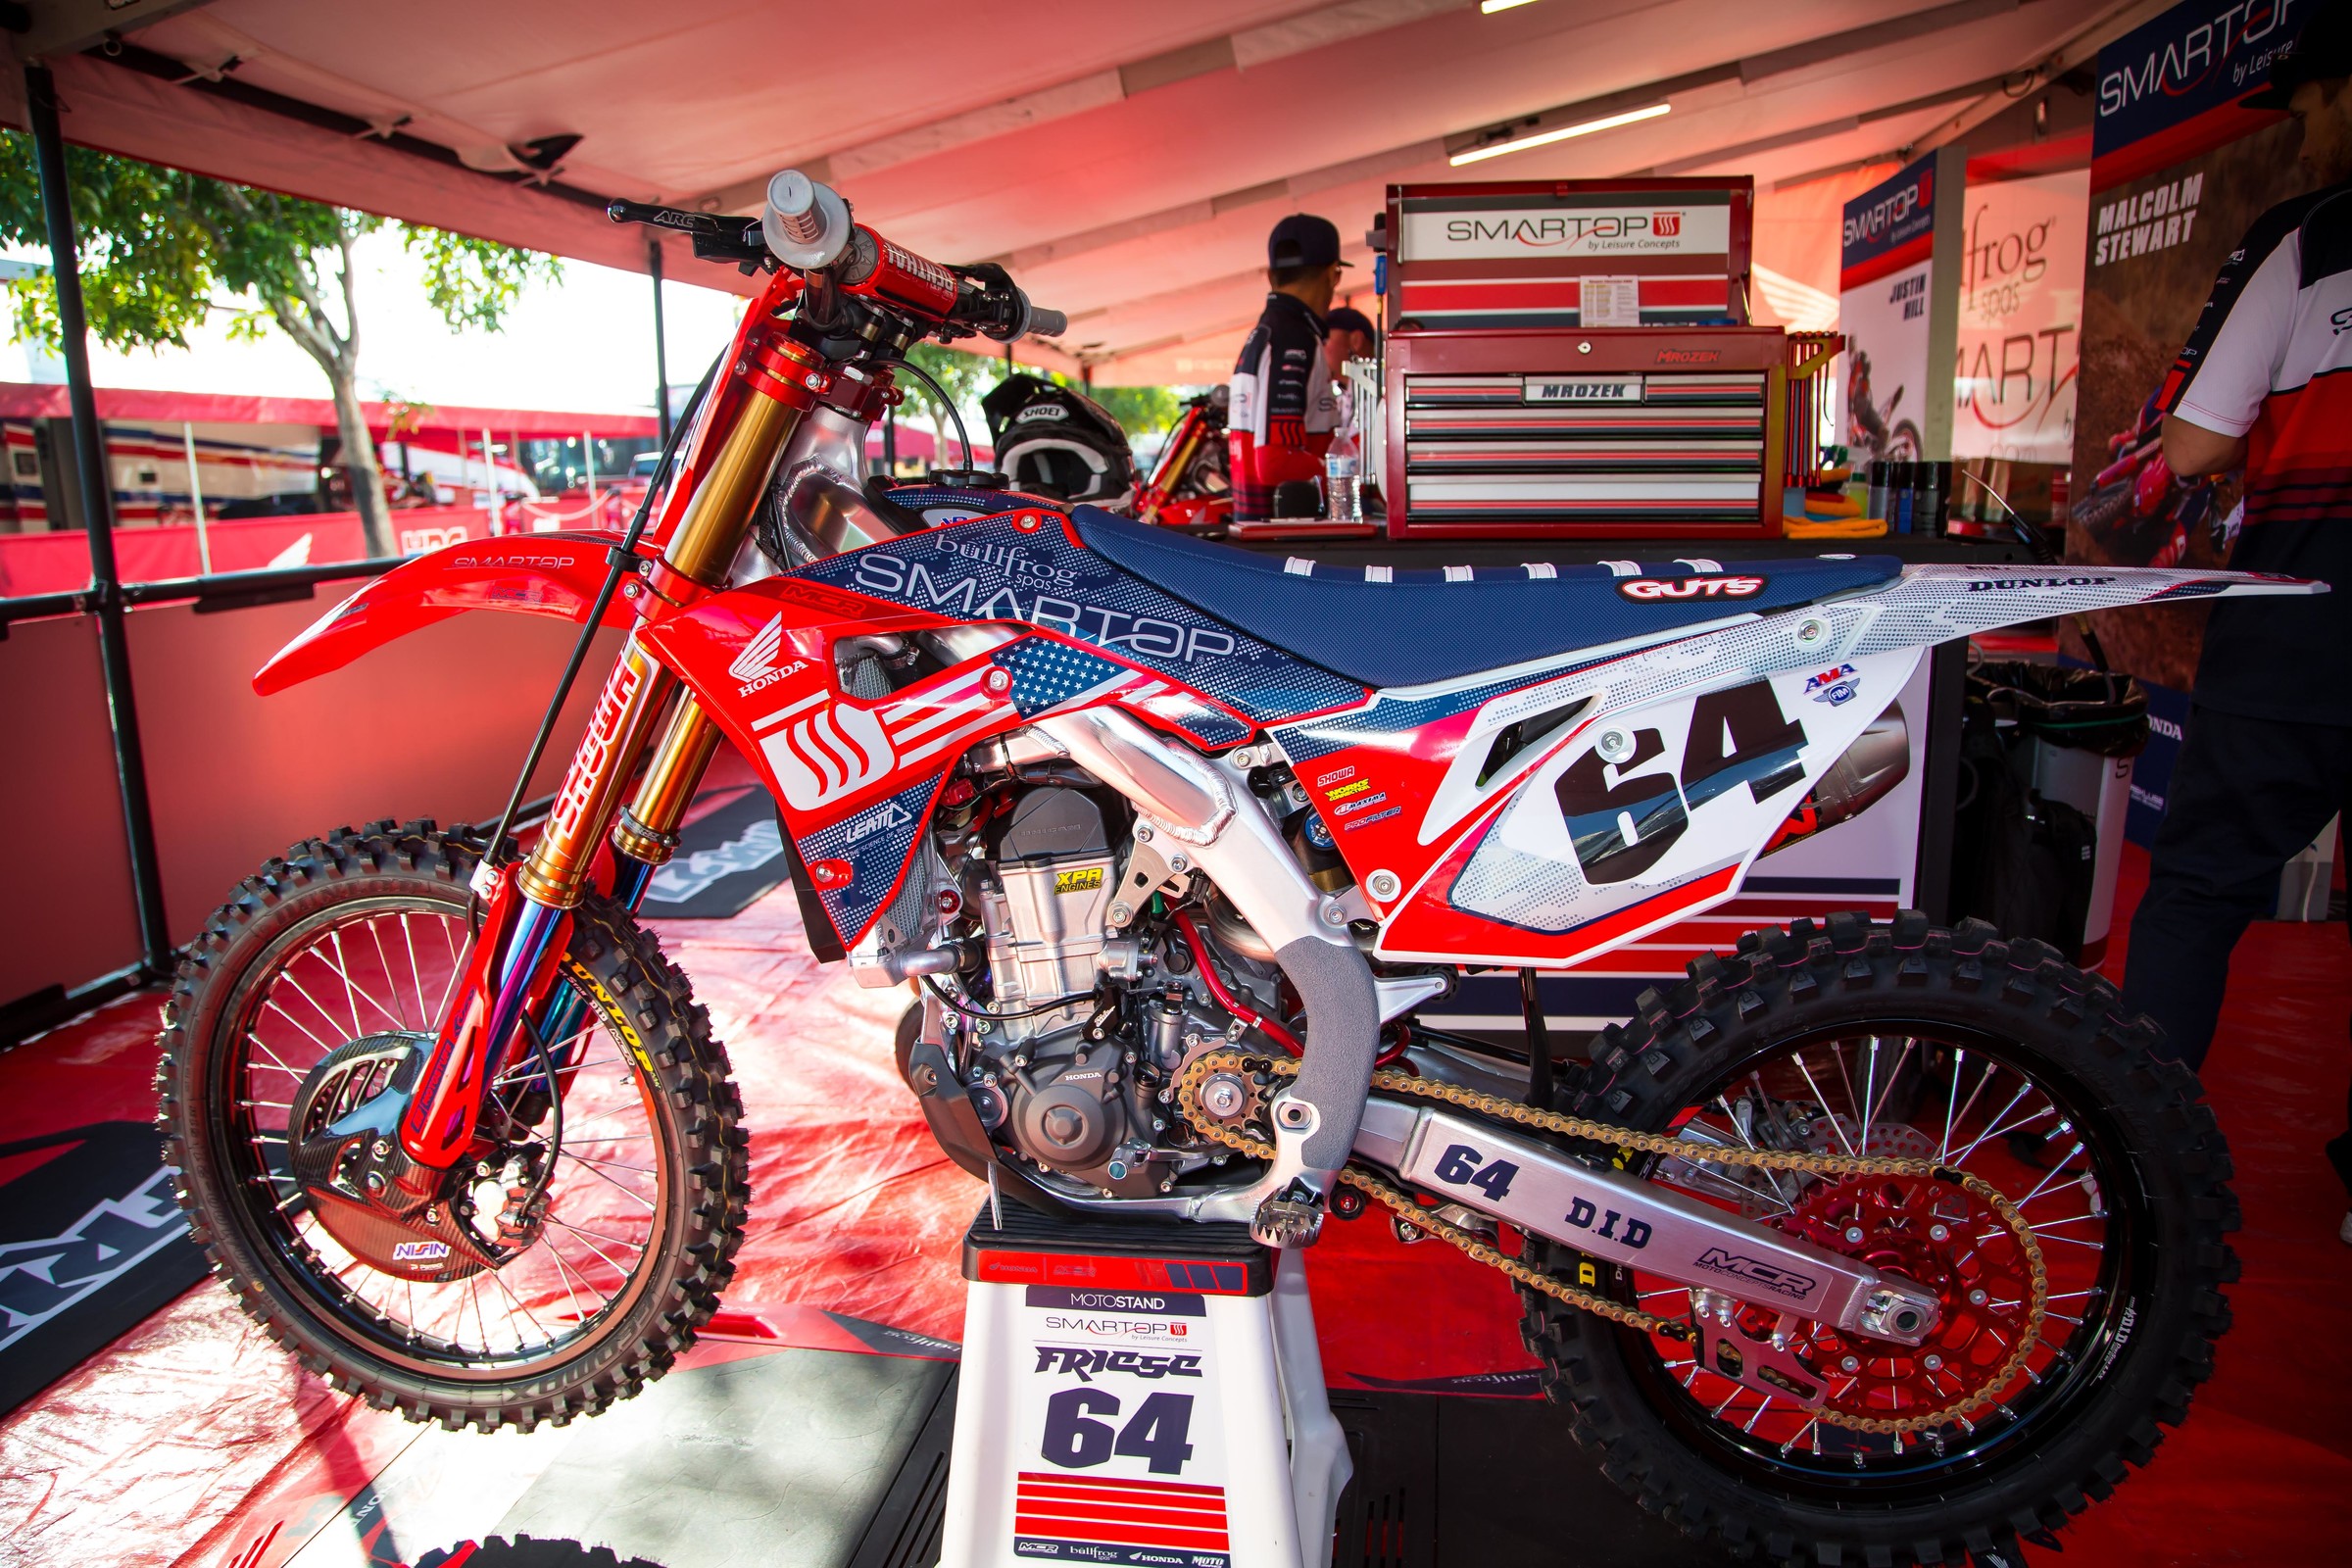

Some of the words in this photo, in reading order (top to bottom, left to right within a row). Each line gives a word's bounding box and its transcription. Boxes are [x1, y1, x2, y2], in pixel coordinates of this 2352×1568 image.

[2232, 62, 2248, 87] by
[1843, 183, 1918, 247] SMARTOP
[2097, 172, 2203, 236] MALCOLM
[654, 211, 695, 228] ARC
[1447, 216, 1648, 242] SMARTOP
[1589, 239, 1599, 251] by
[1602, 239, 1636, 250] Leisure
[1639, 238, 1680, 250] Concepts
[2095, 209, 2197, 267] STEWART
[1889, 272, 1927, 305] JUSTIN
[1903, 296, 1925, 321] HILL
[1655, 348, 1720, 364] MROZEK
[1542, 383, 1627, 399] MROZEK
[1023, 407, 1060, 418] SHOEI
[453, 556, 575, 569] SMARTOP
[1015, 572, 1053, 590] spas
[1622, 575, 1764, 600] GUTS
[1968, 576, 2116, 592] DUNLOP
[780, 585, 866, 617] MCR
[855, 553, 1235, 662] SMARTOP
[738, 660, 808, 698] HONDA
[1803, 662, 1857, 695] AMA
[1831, 687, 1849, 700] FIM
[551, 649, 642, 841] SHOWA
[1318, 766, 1354, 786] SHOWA
[1554, 679, 1809, 885] 64
[1348, 792, 1386, 809] MAXIMA
[1345, 807, 1401, 831] PROFILTER
[850, 847, 860, 857] THE
[861, 835, 886, 852] SCIENCE
[886, 830, 895, 840] OF
[896, 823, 914, 835] THRILL
[1054, 880, 1102, 895] ENGINES
[1065, 1072, 1102, 1081] HONDA
[1434, 1144, 1520, 1202] 64
[1565, 1196, 1653, 1250] D.I.D
[1698, 1247, 1816, 1297] MCR
[1070, 1293, 1165, 1310] MOTOSTAND
[1046, 1316, 1168, 1335] SMARTOP
[1041, 1387, 1195, 1476] 64
[1142, 1554, 1184, 1565] HONDA
[1191, 1555, 1225, 1567] MOTO
